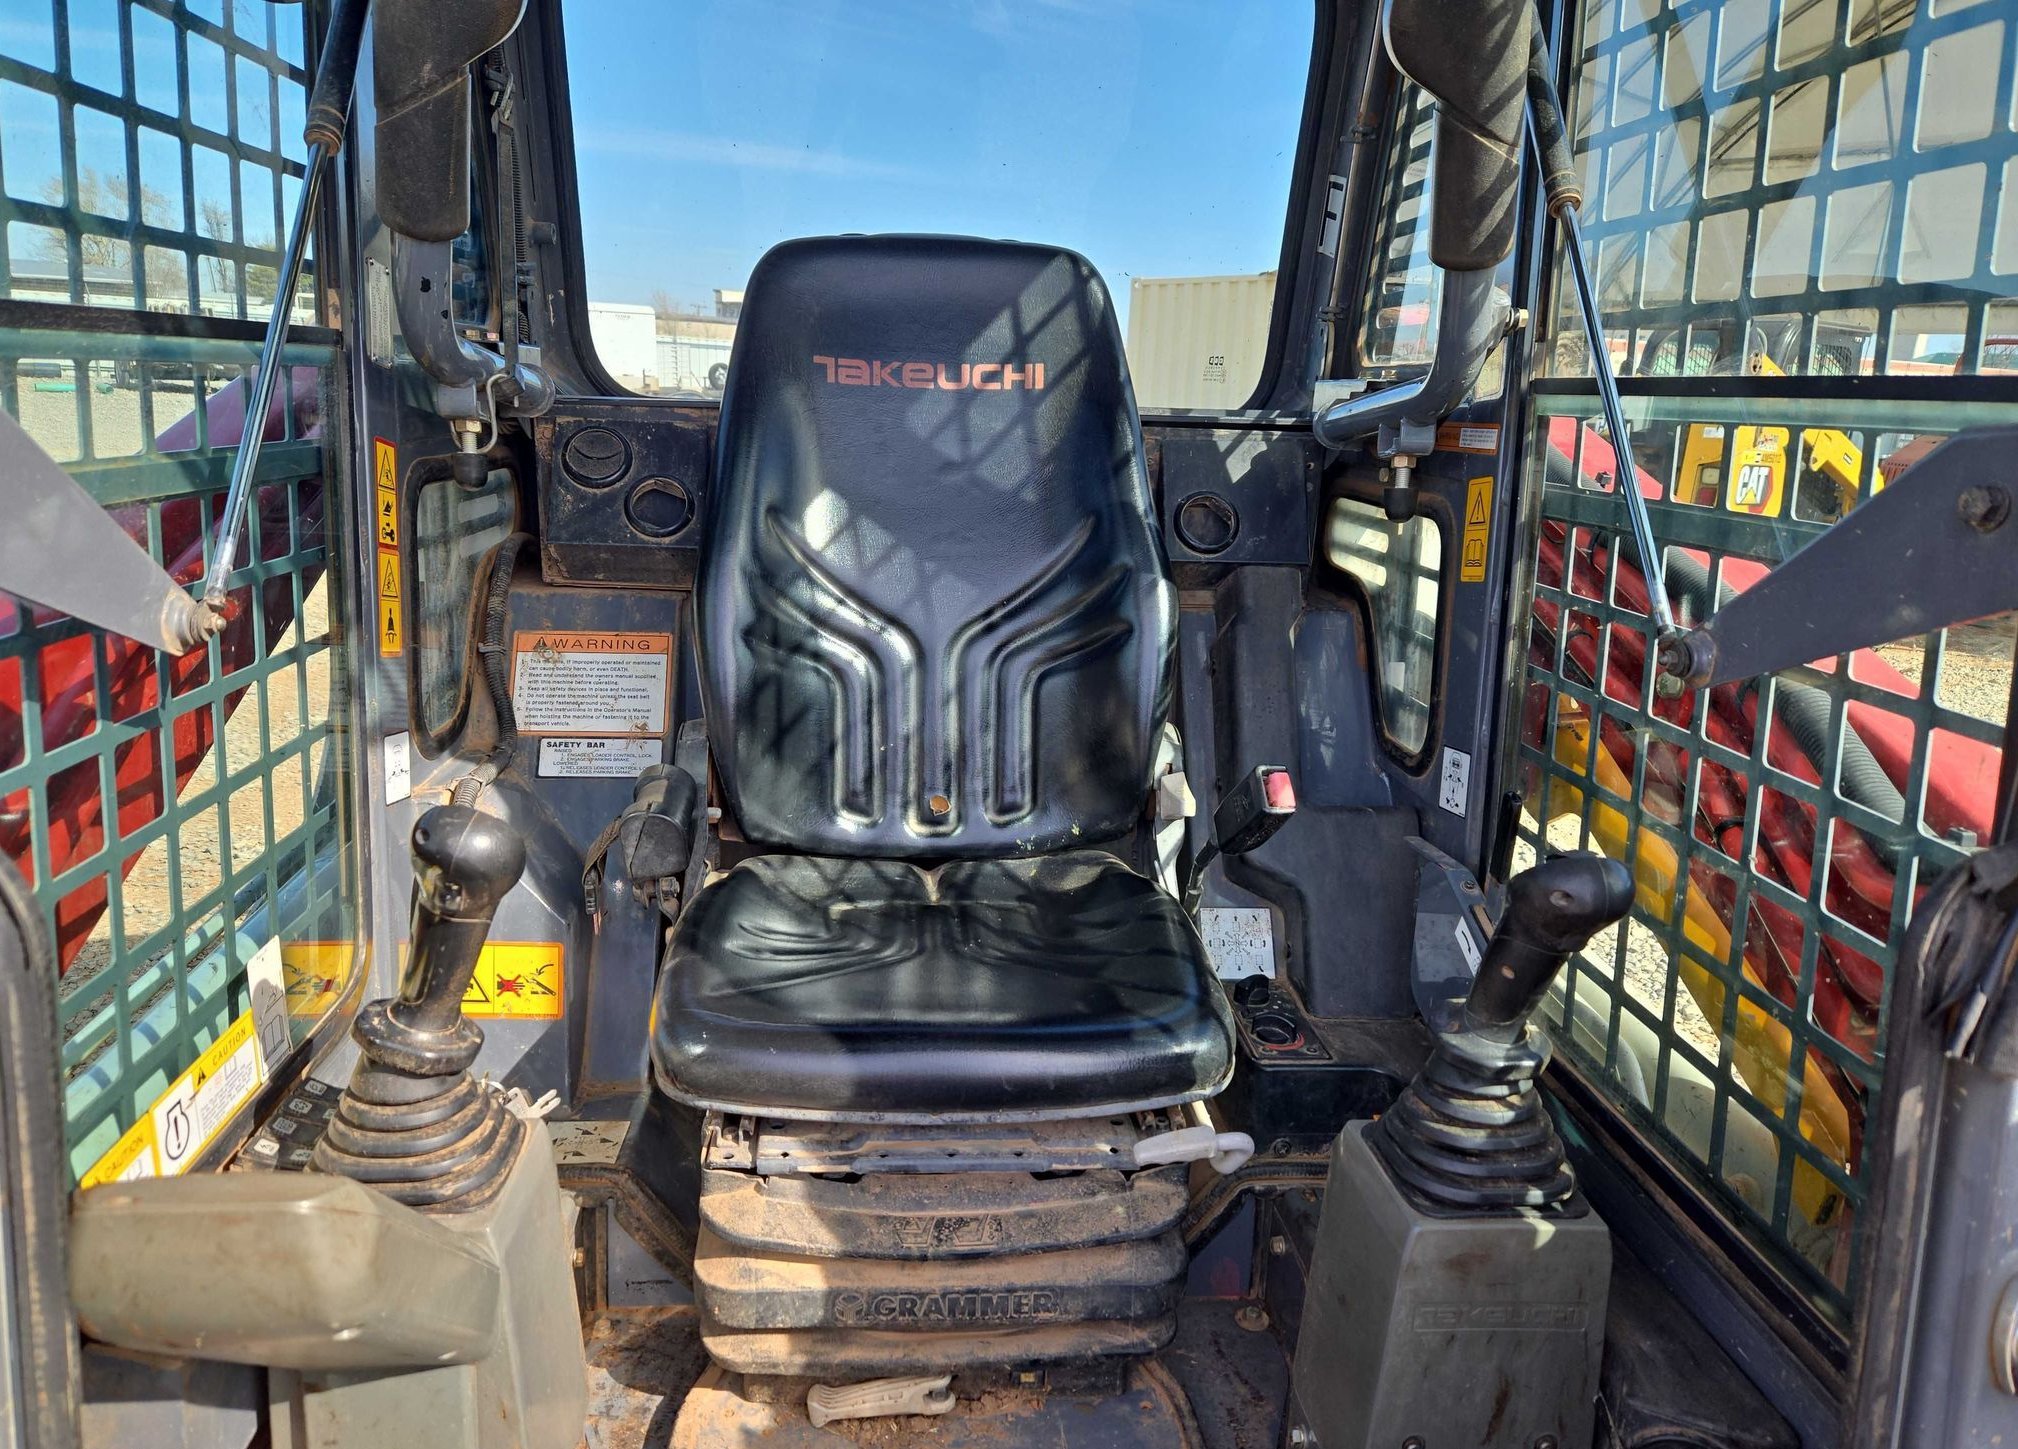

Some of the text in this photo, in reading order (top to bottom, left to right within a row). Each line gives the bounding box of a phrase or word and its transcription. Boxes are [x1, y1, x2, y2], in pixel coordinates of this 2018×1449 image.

[813, 354, 1045, 390] TAKEUCHI
[1735, 465, 1771, 505] CAT
[553, 638, 651, 650] WARNING
[212, 1026, 247, 1066] CAUTION
[104, 1135, 144, 1178] CAUTION
[872, 1291, 1061, 1320] GRAMMER
